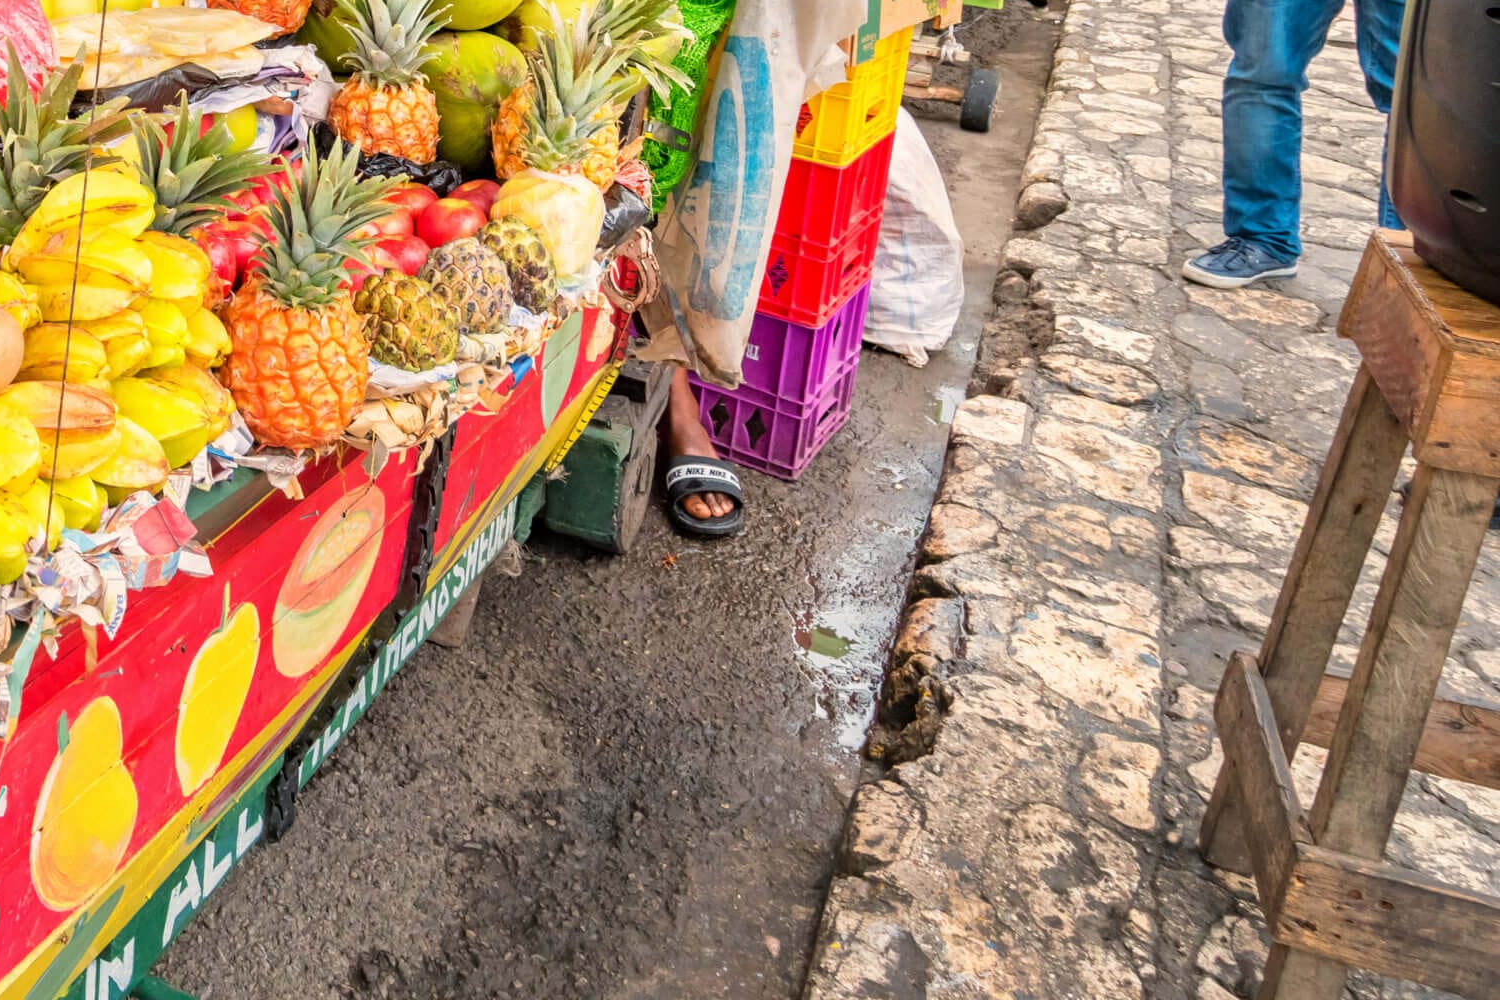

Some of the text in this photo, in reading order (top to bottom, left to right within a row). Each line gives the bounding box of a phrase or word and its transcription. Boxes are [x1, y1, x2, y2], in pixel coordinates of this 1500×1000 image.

[686, 468, 705, 476] NIKE
[709, 469, 727, 477] NIKE
[107, 594, 124, 635] BANK
[162, 807, 264, 948] ALL
